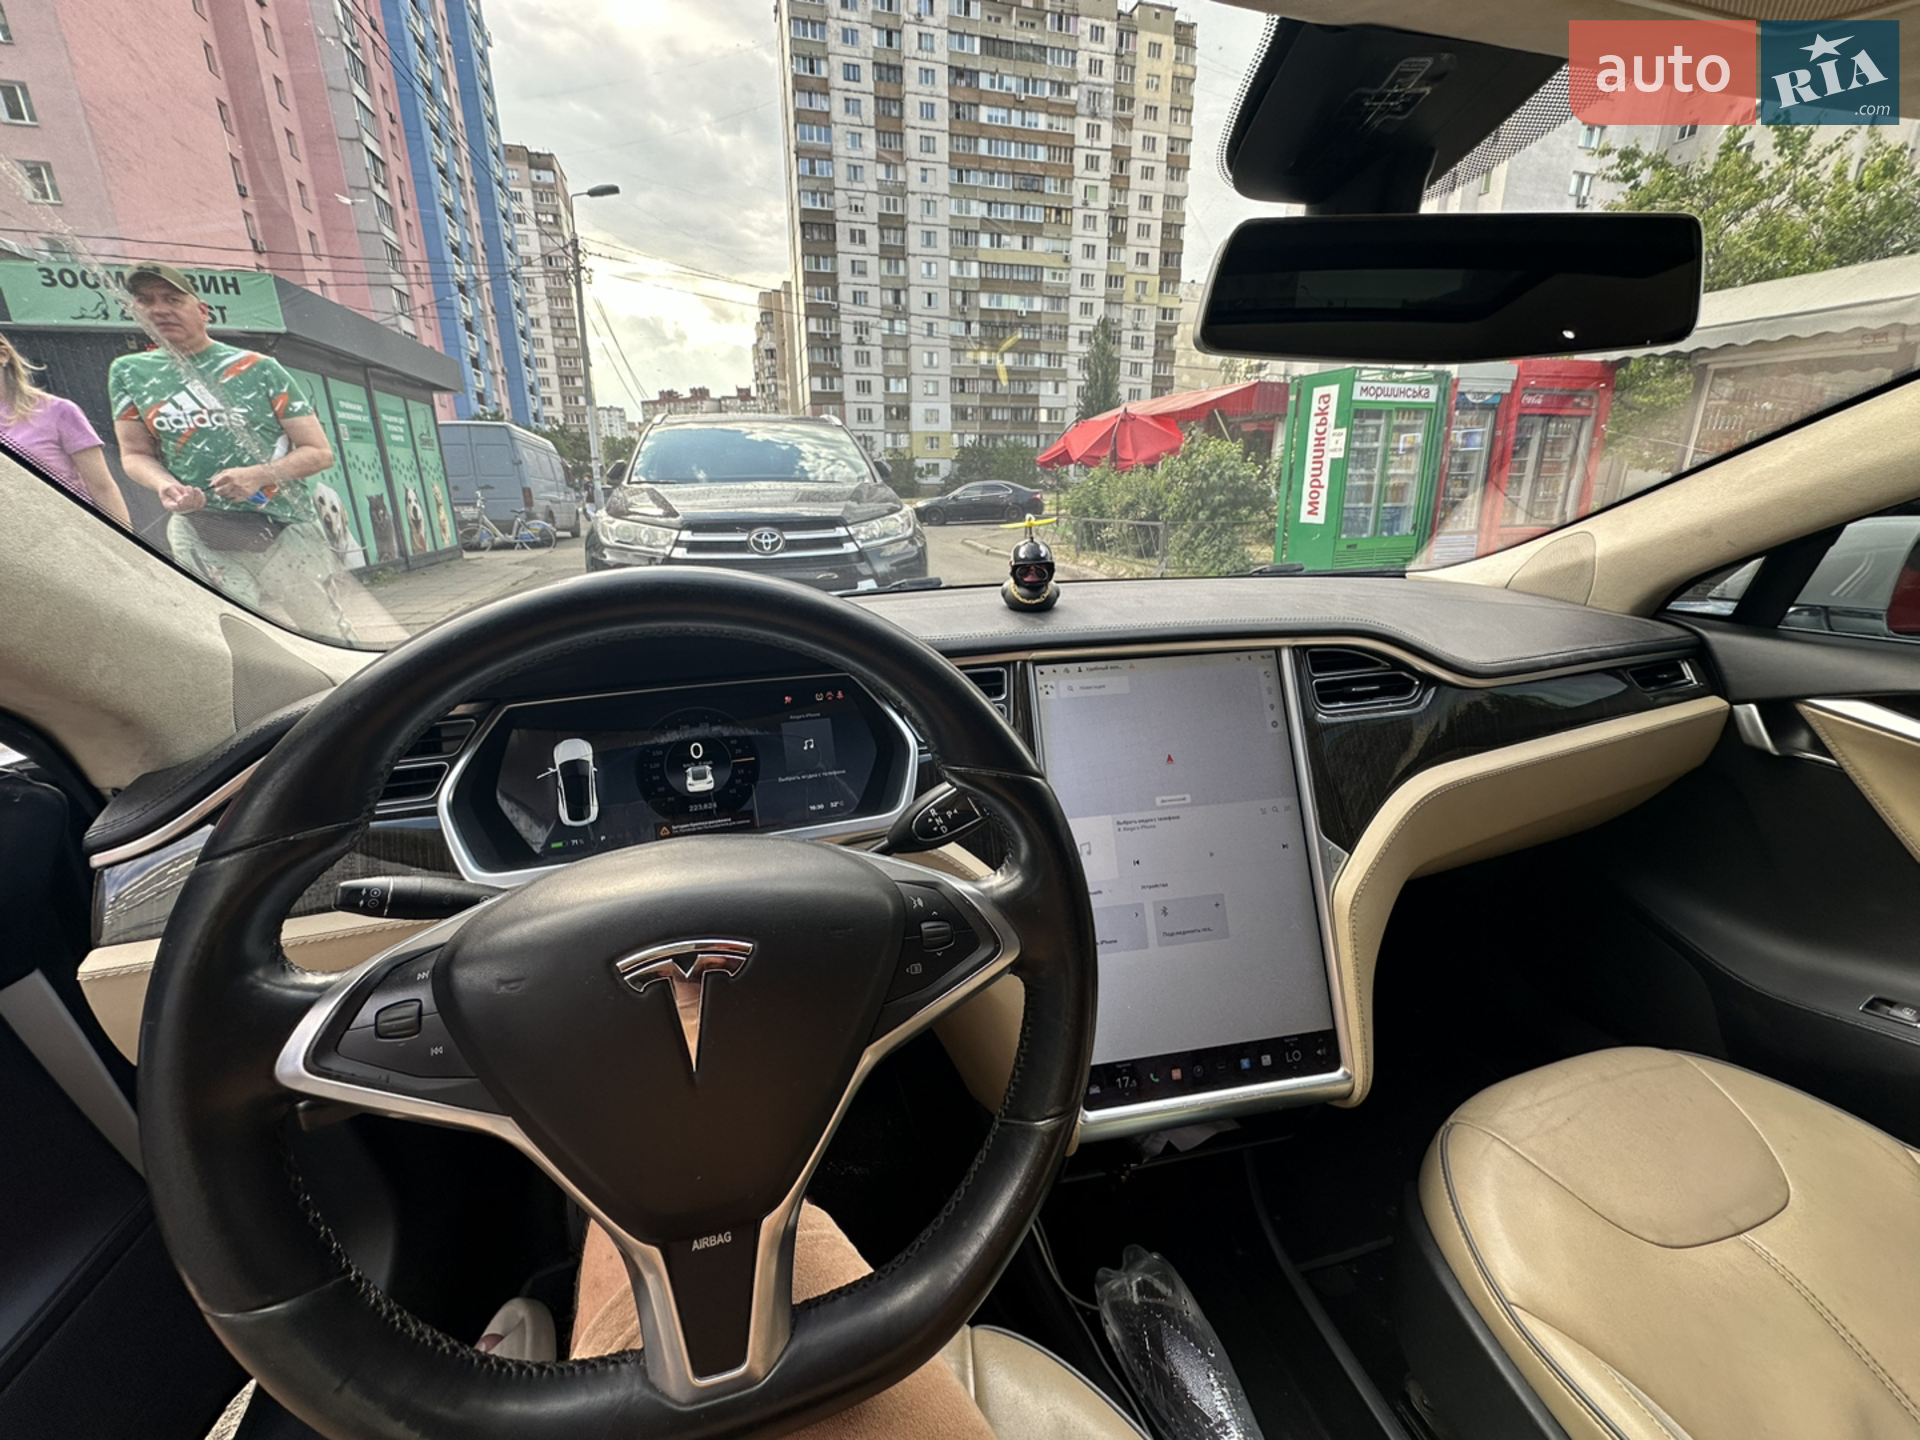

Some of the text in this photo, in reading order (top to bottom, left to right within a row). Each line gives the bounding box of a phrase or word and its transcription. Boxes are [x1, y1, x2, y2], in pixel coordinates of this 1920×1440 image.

[152, 409, 247, 431] adidas
[690, 742, 704, 759] 0
[929, 808, 938, 817] R
[945, 810, 953, 819] P
[940, 825, 948, 834] D
[1285, 1050, 1302, 1063] LO
[691, 1231, 732, 1252] AIRBAG
